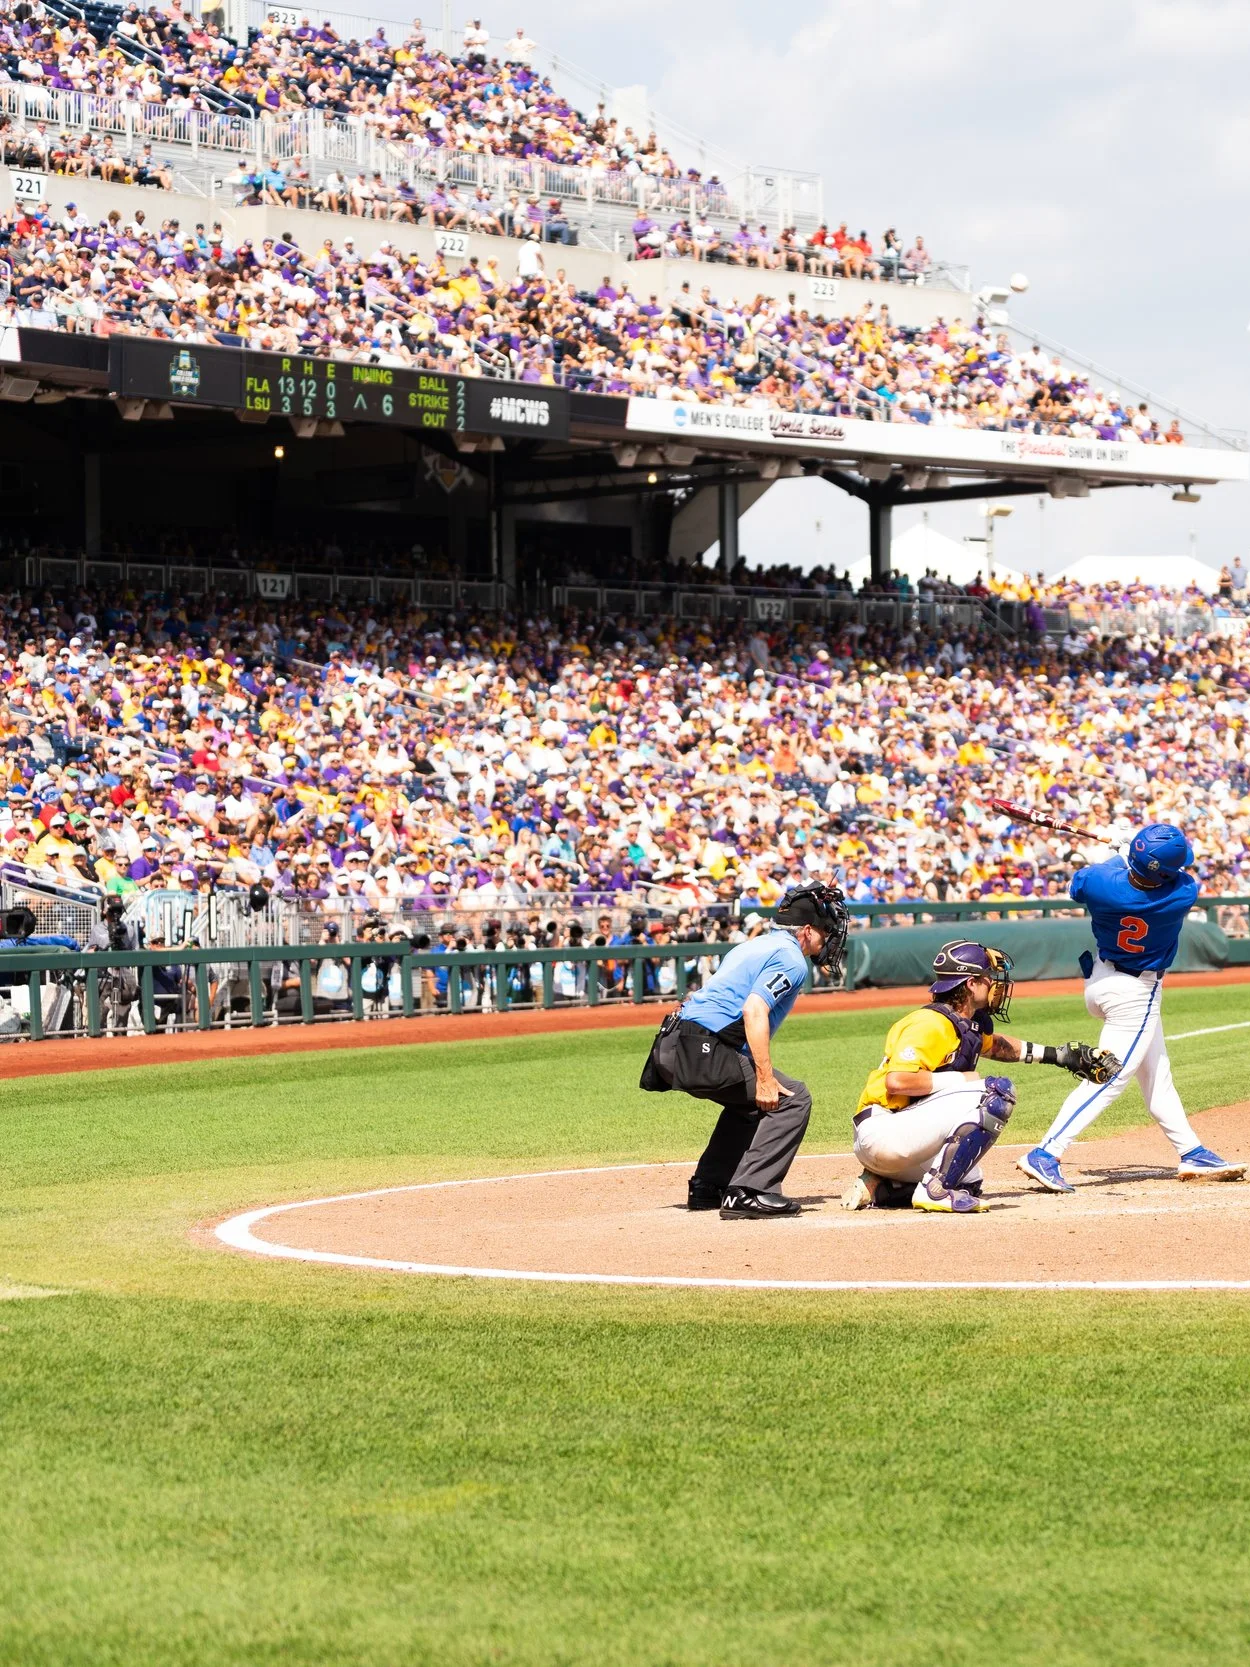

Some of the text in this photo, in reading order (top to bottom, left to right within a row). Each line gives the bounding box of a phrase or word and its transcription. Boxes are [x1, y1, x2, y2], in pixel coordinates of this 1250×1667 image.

[274, 11, 296, 25] 323
[16, 177, 41, 195] 221
[441, 236, 464, 252] 222
[813, 282, 834, 296] 223
[282, 358, 393, 385] R H E INNING
[246, 376, 336, 398] FLA 13 12 0
[419, 376, 465, 397] BALL 2
[246, 396, 336, 418] LSU 3 5 3
[382, 394, 394, 416] 6
[408, 393, 465, 415] STRIKE 2
[489, 397, 550, 426] #MCWS
[422, 413, 465, 432] OUT 2
[691, 411, 721, 427] MEN'S
[724, 414, 764, 431] COLLEGE
[769, 414, 804, 434] World
[809, 418, 844, 437] Series
[1000, 440, 1016, 454] THE
[1068, 446, 1093, 459] SHOW
[1096, 447, 1108, 460] ON
[1110, 448, 1129, 461] DIRT
[262, 578, 285, 593] 121
[1117, 916, 1149, 953] 2
[764, 972, 792, 1000] 17
[701, 1042, 711, 1053] S
[723, 1195, 738, 1208] N
